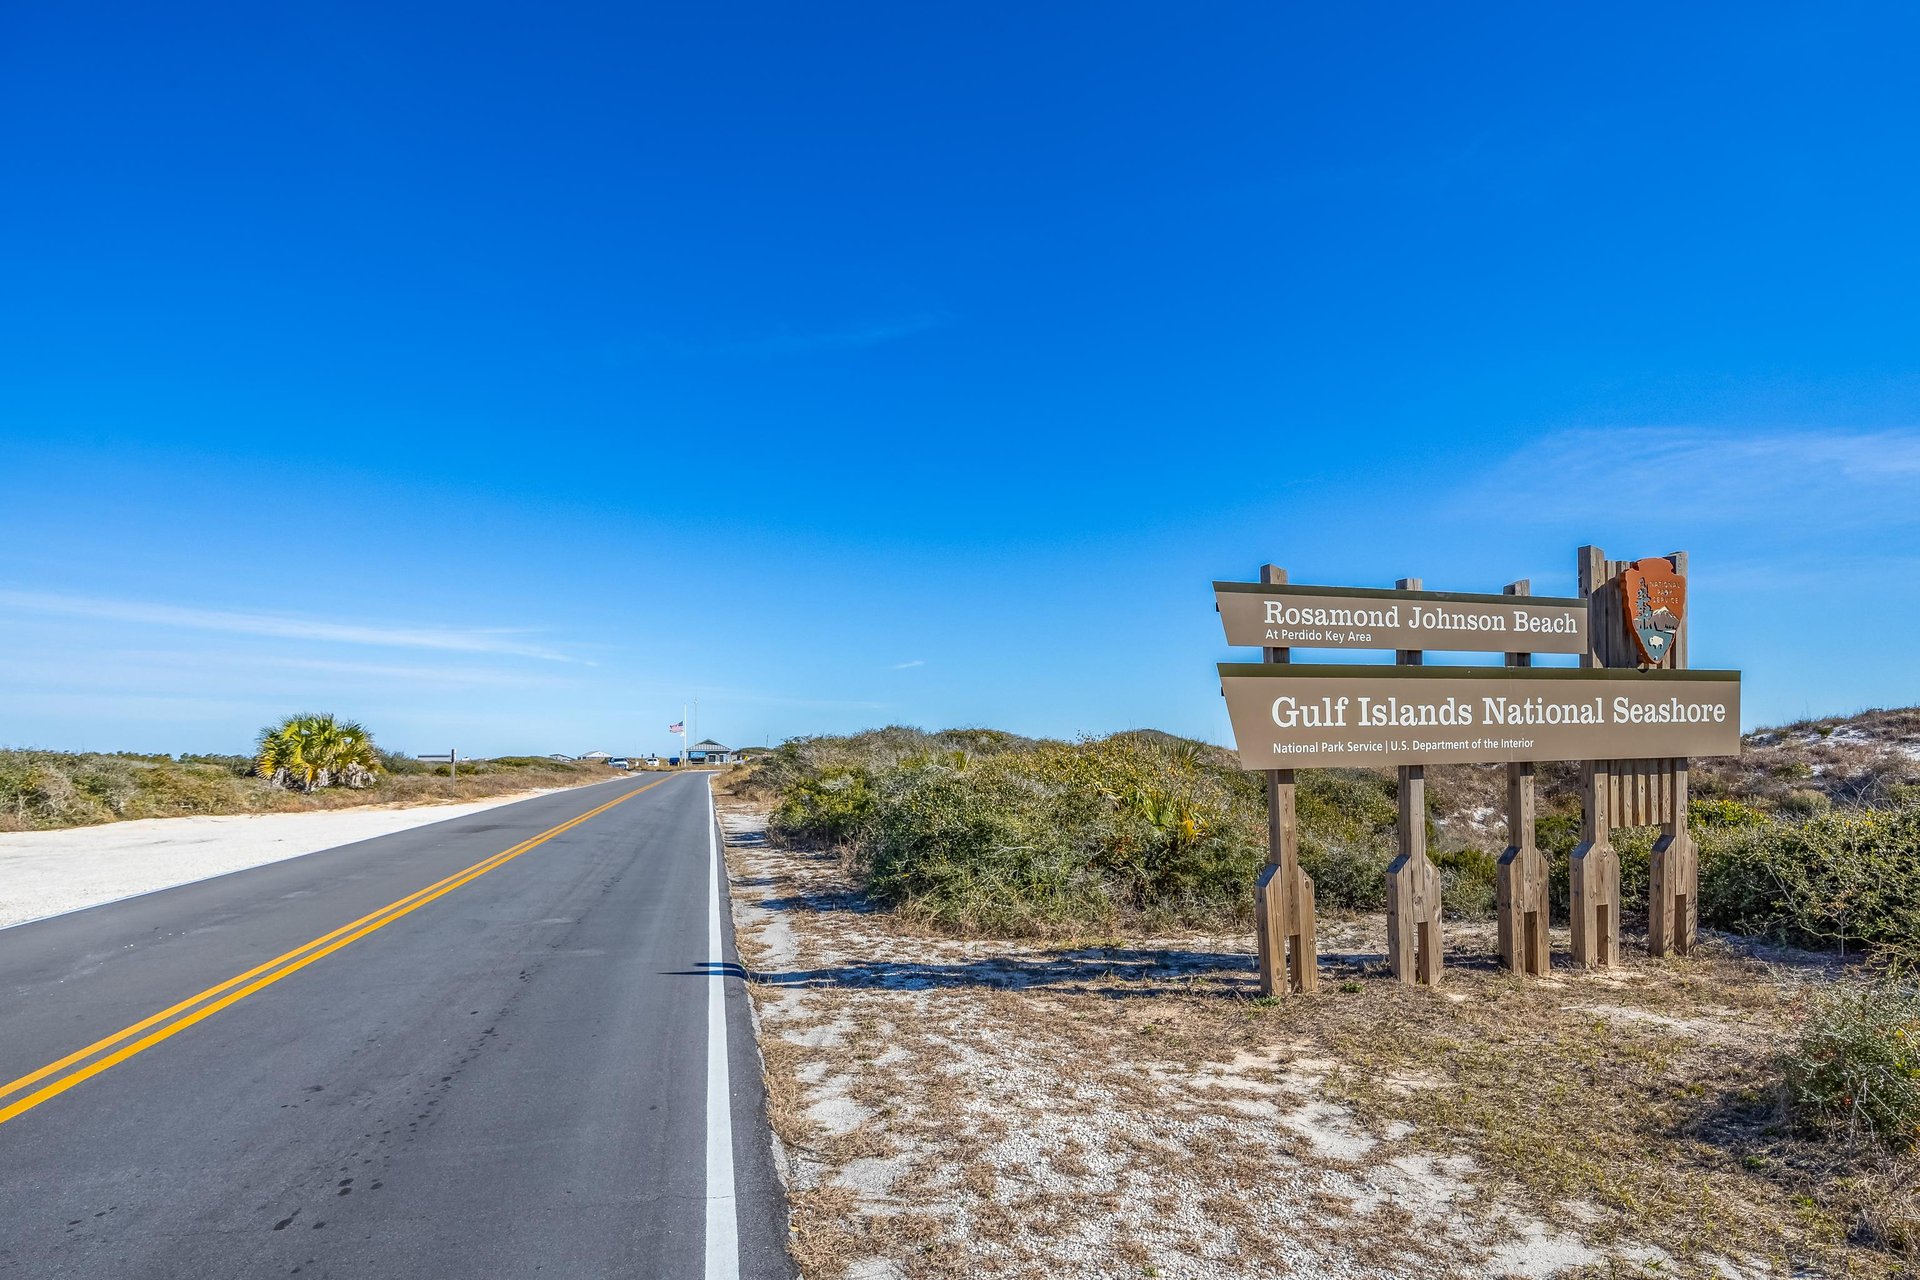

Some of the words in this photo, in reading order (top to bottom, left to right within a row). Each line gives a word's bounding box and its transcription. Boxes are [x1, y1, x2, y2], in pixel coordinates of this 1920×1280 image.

[1264, 600, 1400, 628] Rosamond
[1409, 606, 1506, 631] Johnson
[1513, 611, 1578, 634] Beach
[1266, 629, 1278, 640] At
[1282, 630, 1322, 641] Perdido
[1325, 630, 1345, 643] Key
[1348, 631, 1372, 642] Area
[1272, 696, 1349, 728] Gulf
[1358, 696, 1472, 727] Islands
[1482, 697, 1604, 726] National
[1613, 696, 1726, 724] Seashore
[1273, 742, 1318, 754] National
[1322, 741, 1344, 753] Park
[1347, 740, 1382, 752] Service
[1391, 740, 1410, 751] U.S.
[1412, 740, 1469, 753] Department
[1472, 739, 1482, 750] of
[1484, 738, 1498, 749] the
[1501, 738, 1534, 748] Interior
